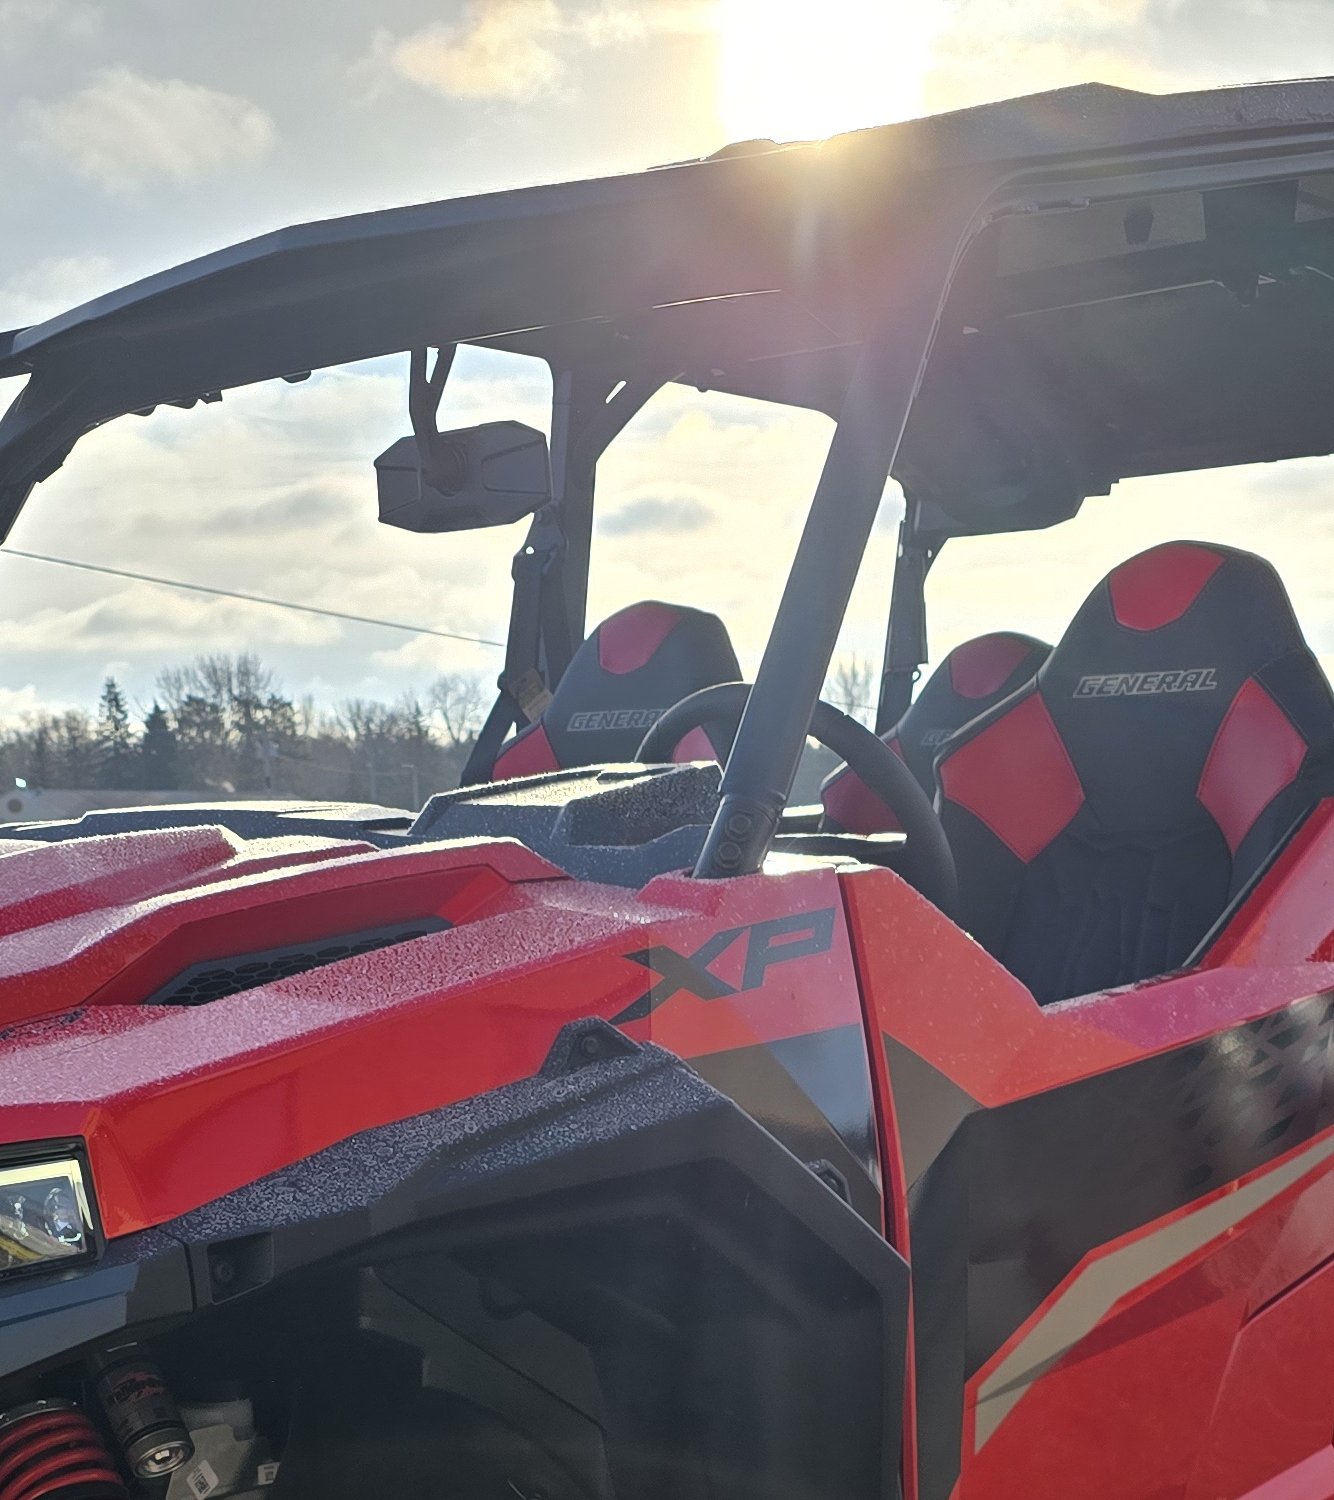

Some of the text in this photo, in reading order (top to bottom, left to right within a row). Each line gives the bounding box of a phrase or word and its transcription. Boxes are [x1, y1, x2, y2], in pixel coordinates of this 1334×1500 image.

[1073, 668, 1217, 698] GENERAL
[567, 708, 668, 732] GENERA
[608, 906, 836, 1025] XP
